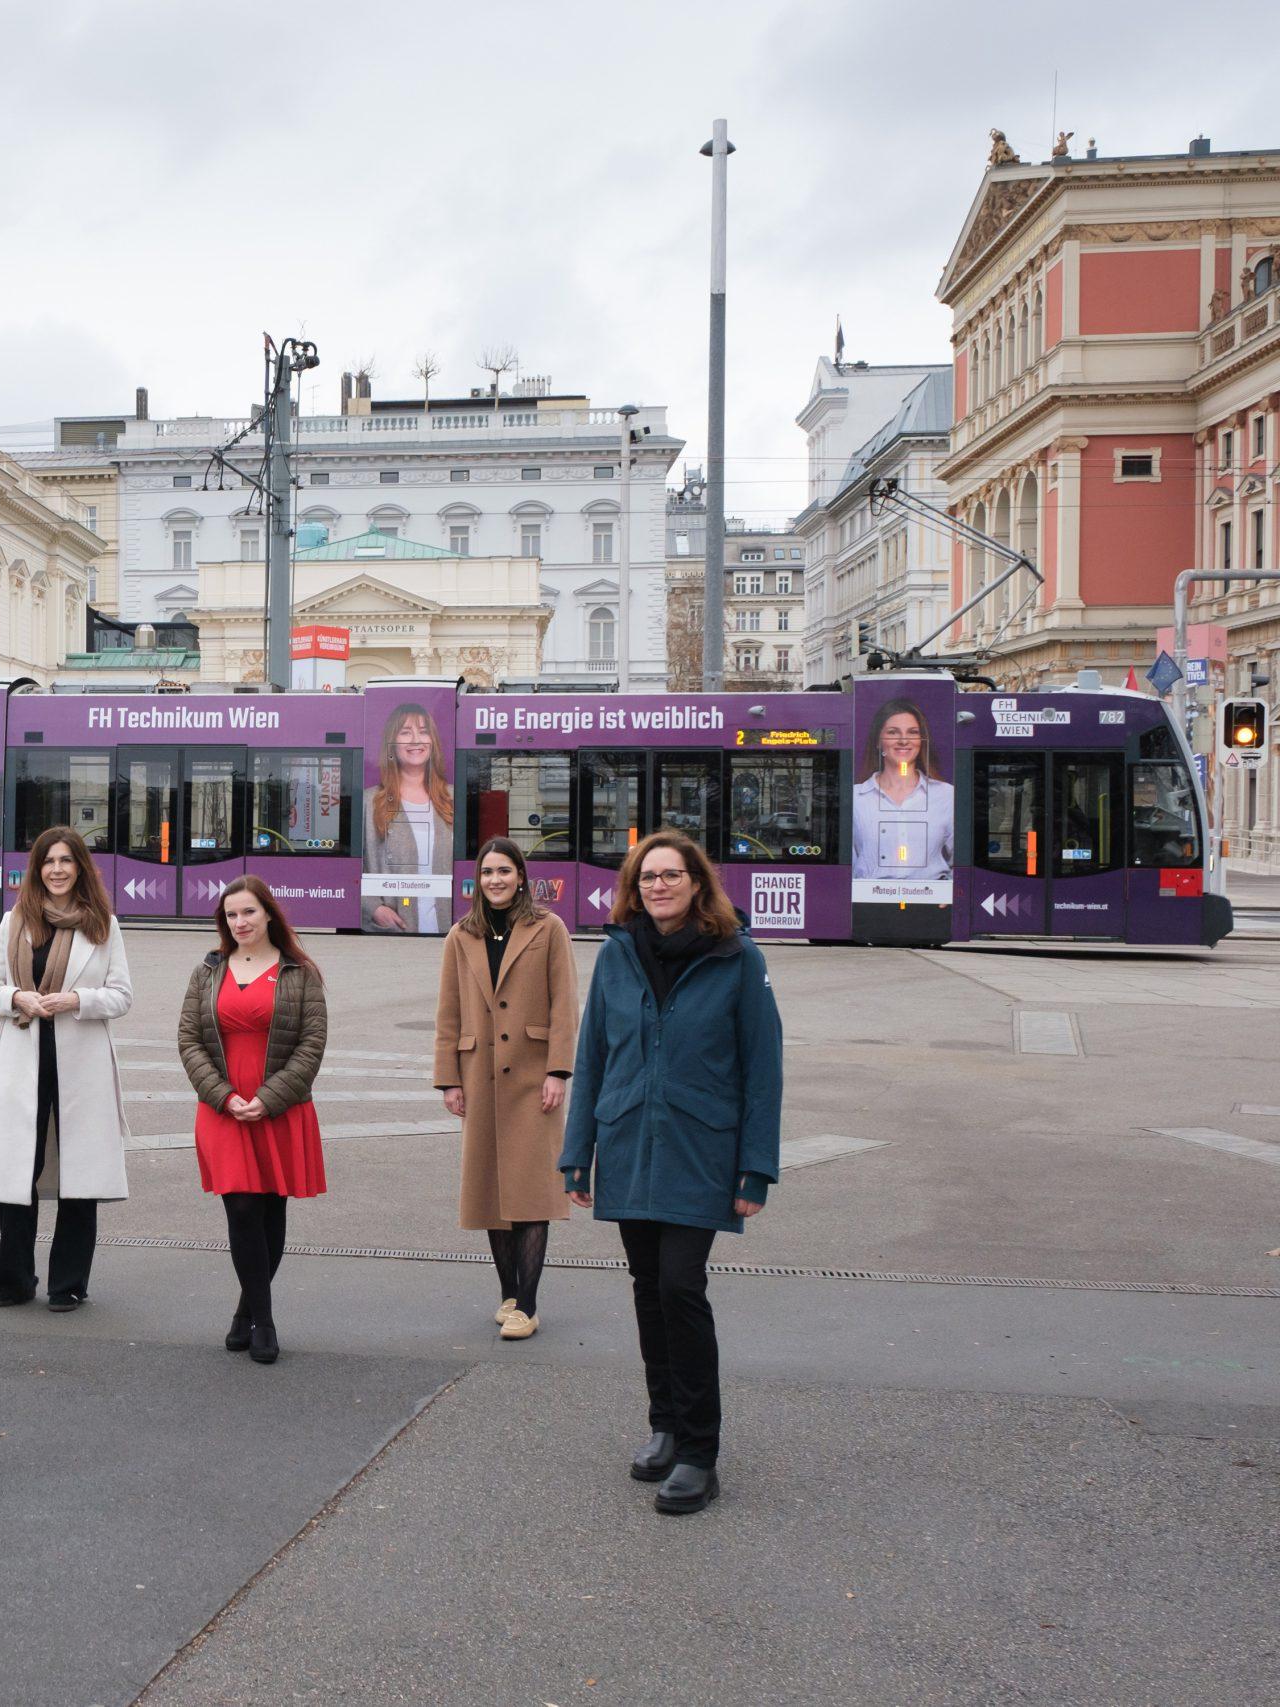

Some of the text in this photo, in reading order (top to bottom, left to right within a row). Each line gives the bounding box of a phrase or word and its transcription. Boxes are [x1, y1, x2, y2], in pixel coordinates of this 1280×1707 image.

[348, 625, 416, 633] STAATSOPER
[998, 700, 1013, 709] FH
[88, 706, 280, 729] FH Technikum Wien
[475, 705, 724, 734] Die Energie ist weiblich
[1100, 711, 1124, 724] 782
[1001, 726, 1030, 735] WIEN
[736, 730, 745, 745] 2
[754, 876, 802, 889] CHANGE
[269, 885, 345, 899] hnikum-wien.at
[754, 891, 801, 915] OUR
[754, 916, 802, 926] TOMORROW
